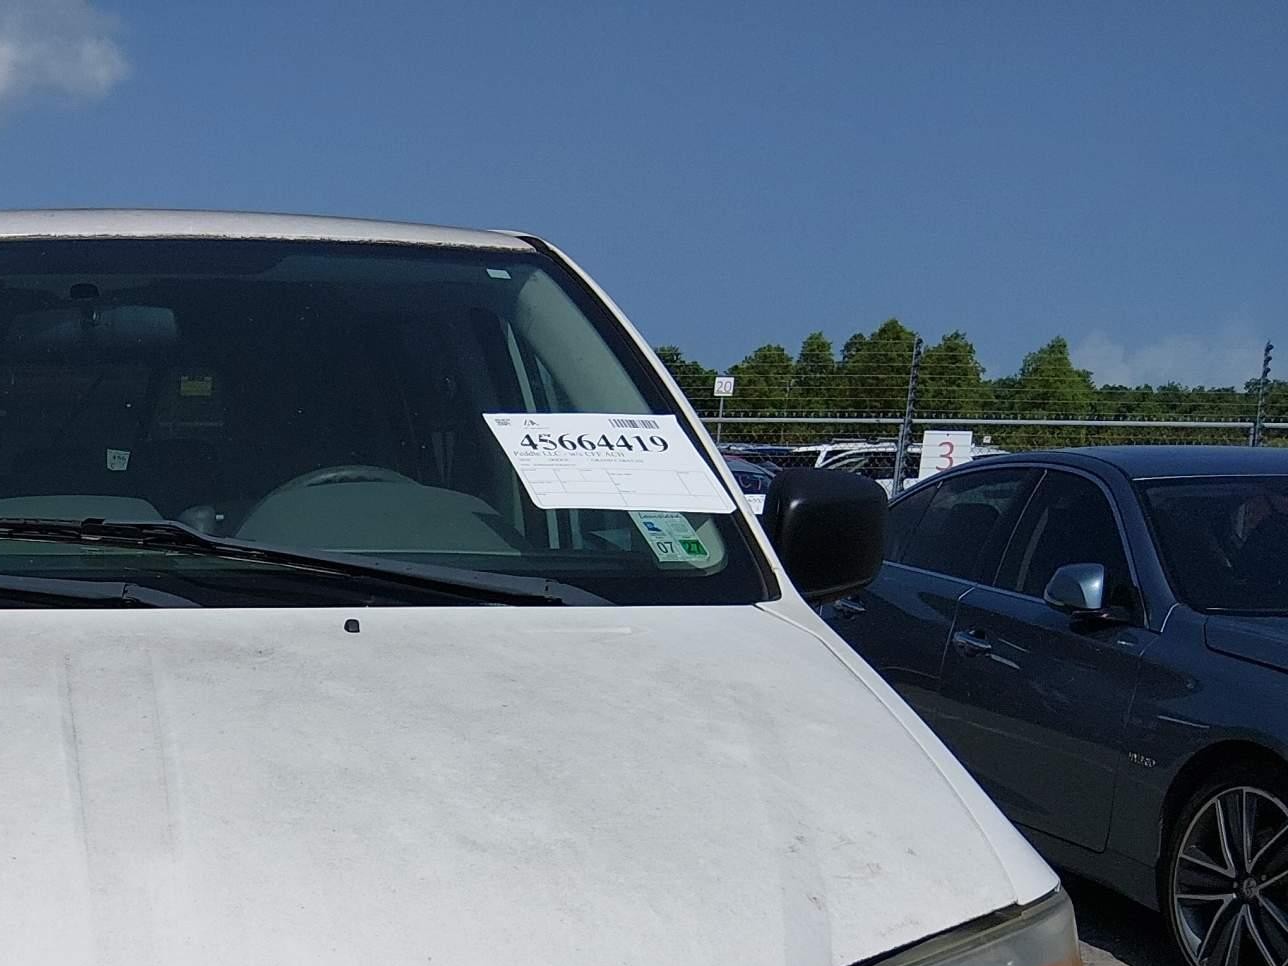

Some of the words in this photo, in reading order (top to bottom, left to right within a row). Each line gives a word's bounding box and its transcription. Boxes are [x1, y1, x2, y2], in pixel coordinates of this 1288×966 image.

[716, 380, 733, 394] 20
[520, 433, 669, 453] 45664419
[935, 441, 954, 472] 3
[656, 541, 675, 554] 07
